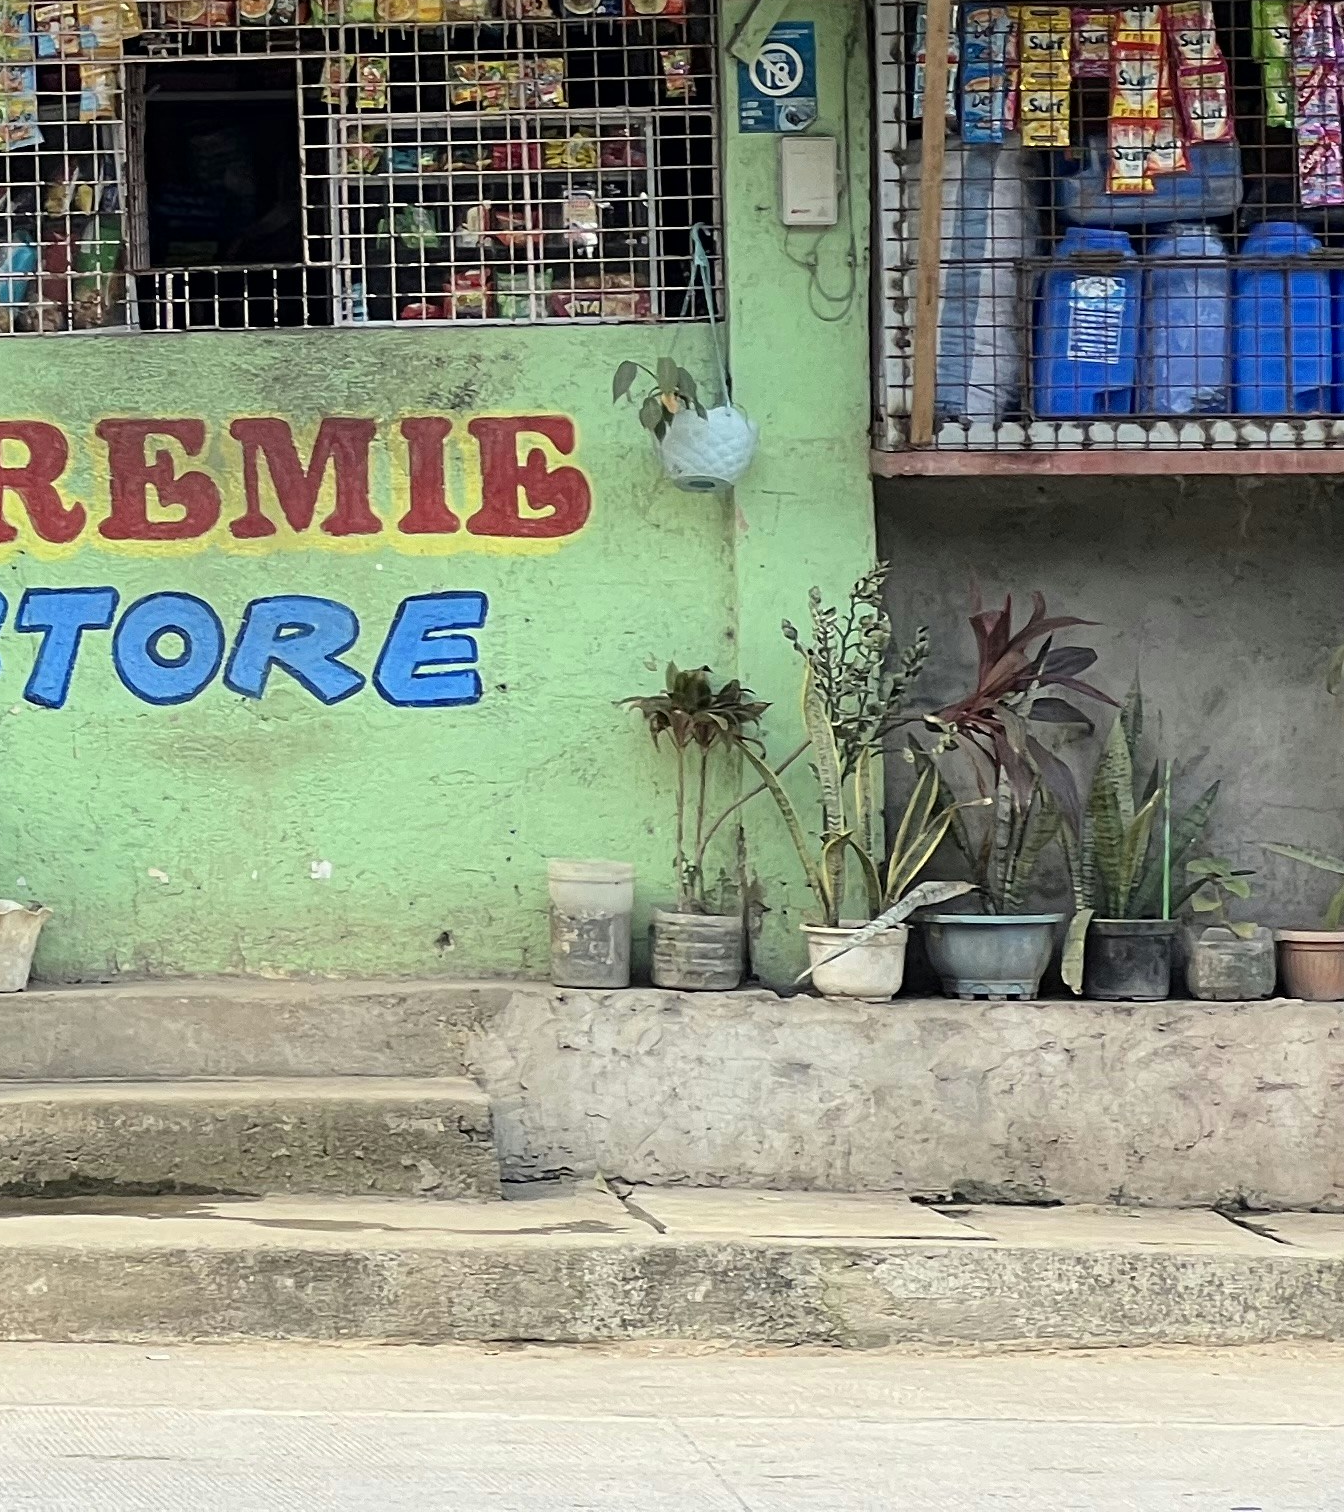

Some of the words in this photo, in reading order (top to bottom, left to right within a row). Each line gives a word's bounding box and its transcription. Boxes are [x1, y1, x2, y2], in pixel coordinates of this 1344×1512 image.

[1029, 35, 1066, 51] Surf
[1118, 69, 1157, 87] Surf
[1029, 97, 1065, 113] Surf
